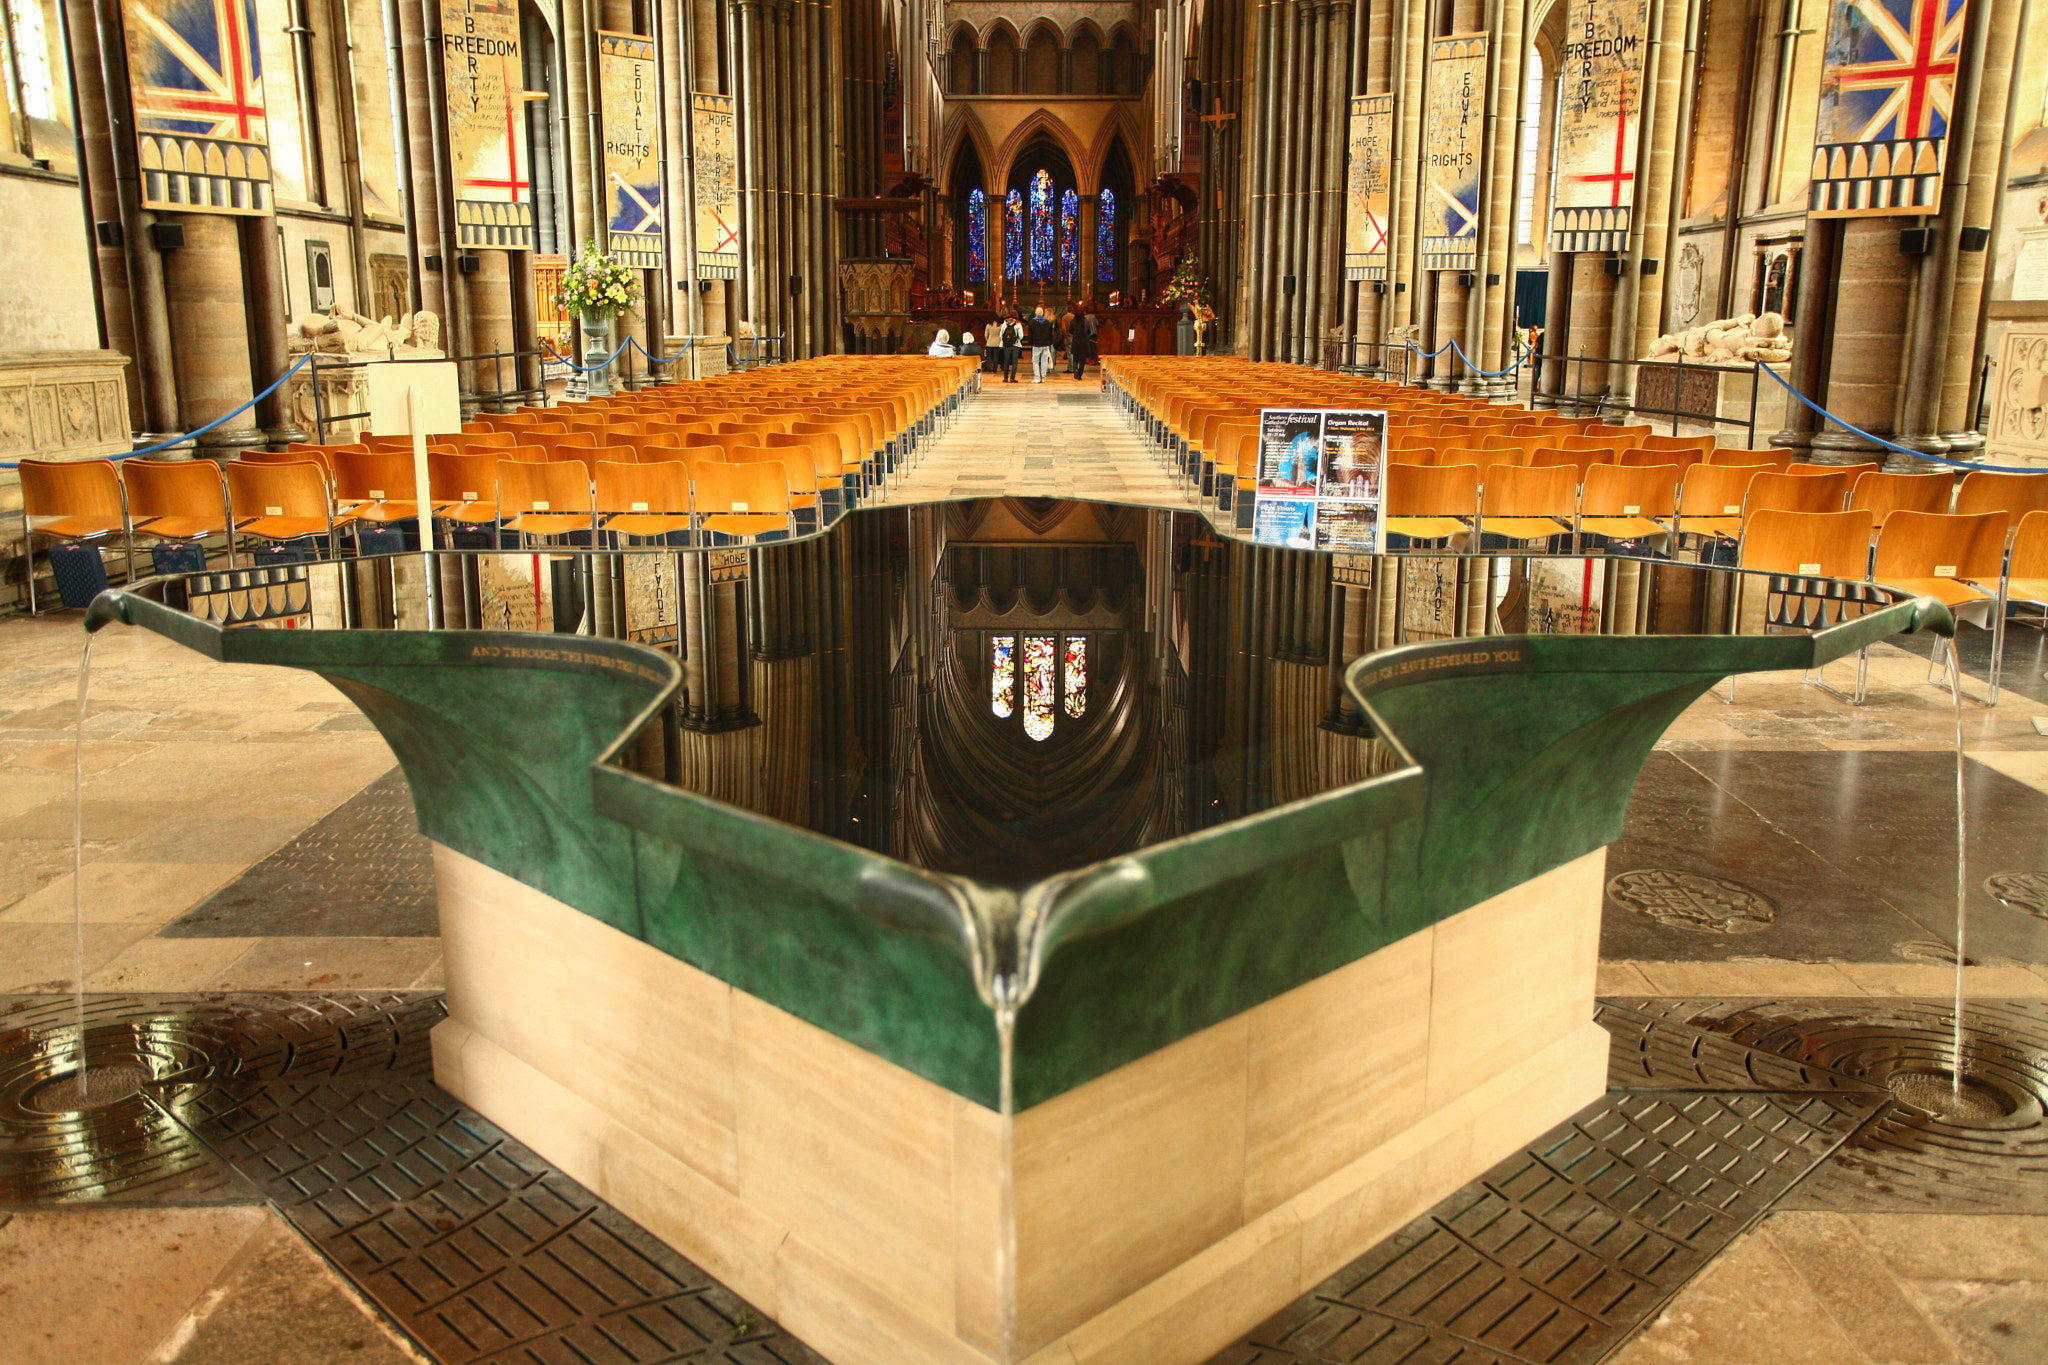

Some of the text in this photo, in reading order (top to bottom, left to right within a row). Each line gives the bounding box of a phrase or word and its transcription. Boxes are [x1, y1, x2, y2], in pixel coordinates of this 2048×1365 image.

[444, 34, 518, 57] FREEDOM
[1565, 35, 1636, 61] FREEDOM
[1577, 0, 1597, 113] IBERTY
[708, 114, 732, 127] HOPE
[1457, 72, 1471, 180] EQUALITY
[607, 141, 650, 158] RIGHTS
[1355, 136, 1378, 147] HOPE
[1431, 153, 1472, 166] RIGHTS
[1363, 116, 1373, 231] OPPORTUNITY
[1286, 414, 1318, 426] festival
[1327, 419, 1346, 427] Organ
[471, 646, 501, 657] AND
[502, 646, 559, 661] THROUGH
[560, 650, 582, 663] THE
[1400, 657, 1427, 675] HAVE
[1428, 651, 1490, 669] REDEEMED
